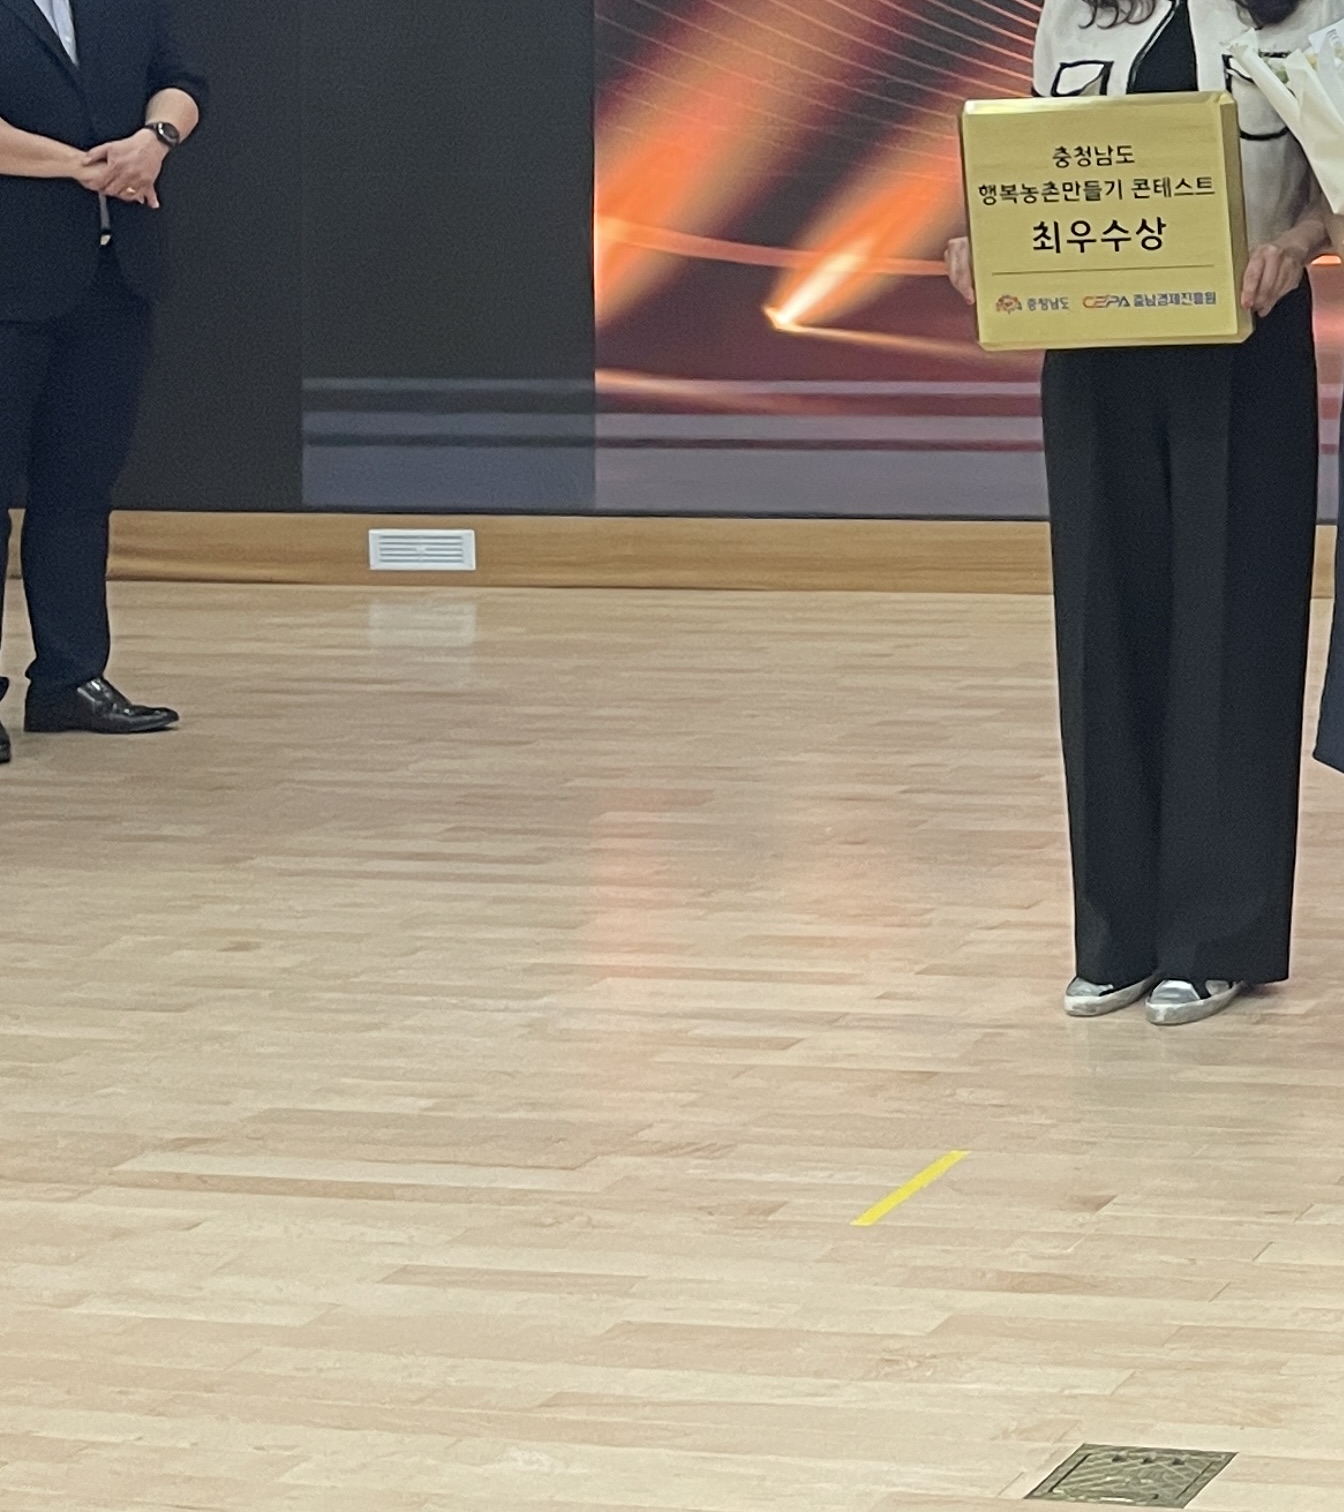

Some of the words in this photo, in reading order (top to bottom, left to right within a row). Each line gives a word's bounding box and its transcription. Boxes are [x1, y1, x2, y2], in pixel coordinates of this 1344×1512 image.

[1053, 144, 1135, 169] 충청남도
[978, 178, 1124, 206] 행복농촌만들기
[1131, 176, 1217, 200] 콘테스트
[1032, 216, 1168, 254] 최우수상
